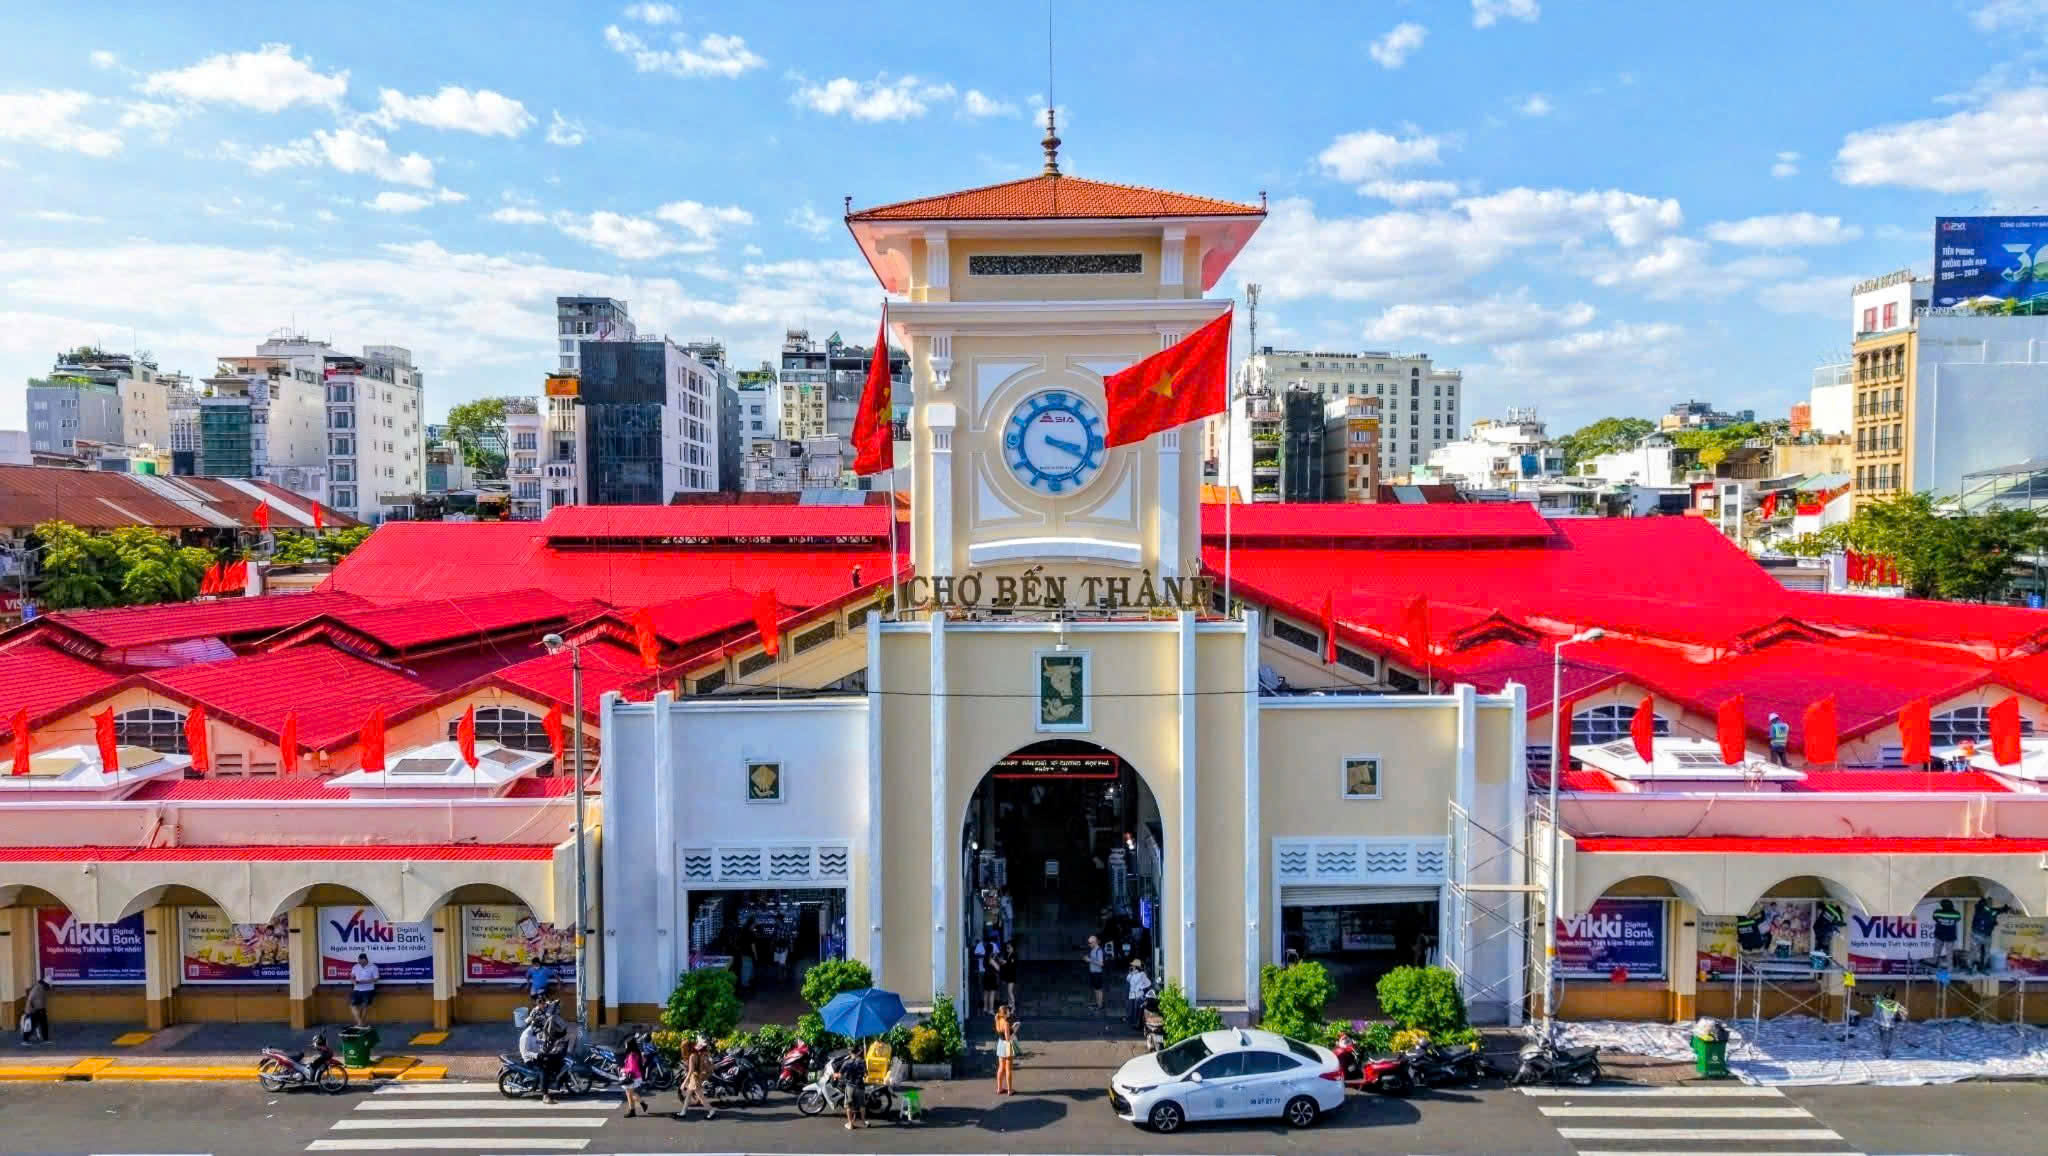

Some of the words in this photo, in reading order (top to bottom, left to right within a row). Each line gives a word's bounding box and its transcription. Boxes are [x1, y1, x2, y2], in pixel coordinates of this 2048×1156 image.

[909, 571, 983, 608] CHỢ
[993, 564, 1066, 608] BẾN
[1081, 568, 1216, 608] THÀNH
[45, 914, 110, 945] Vikki
[330, 908, 395, 943] Vikki
[1561, 913, 1623, 938] Vikki
[1624, 927, 1655, 938] Bank
[1852, 914, 1917, 938] Vikki
[1920, 928, 1936, 939] Ba
[112, 934, 142, 945] Bank
[397, 933, 426, 943] Bank
